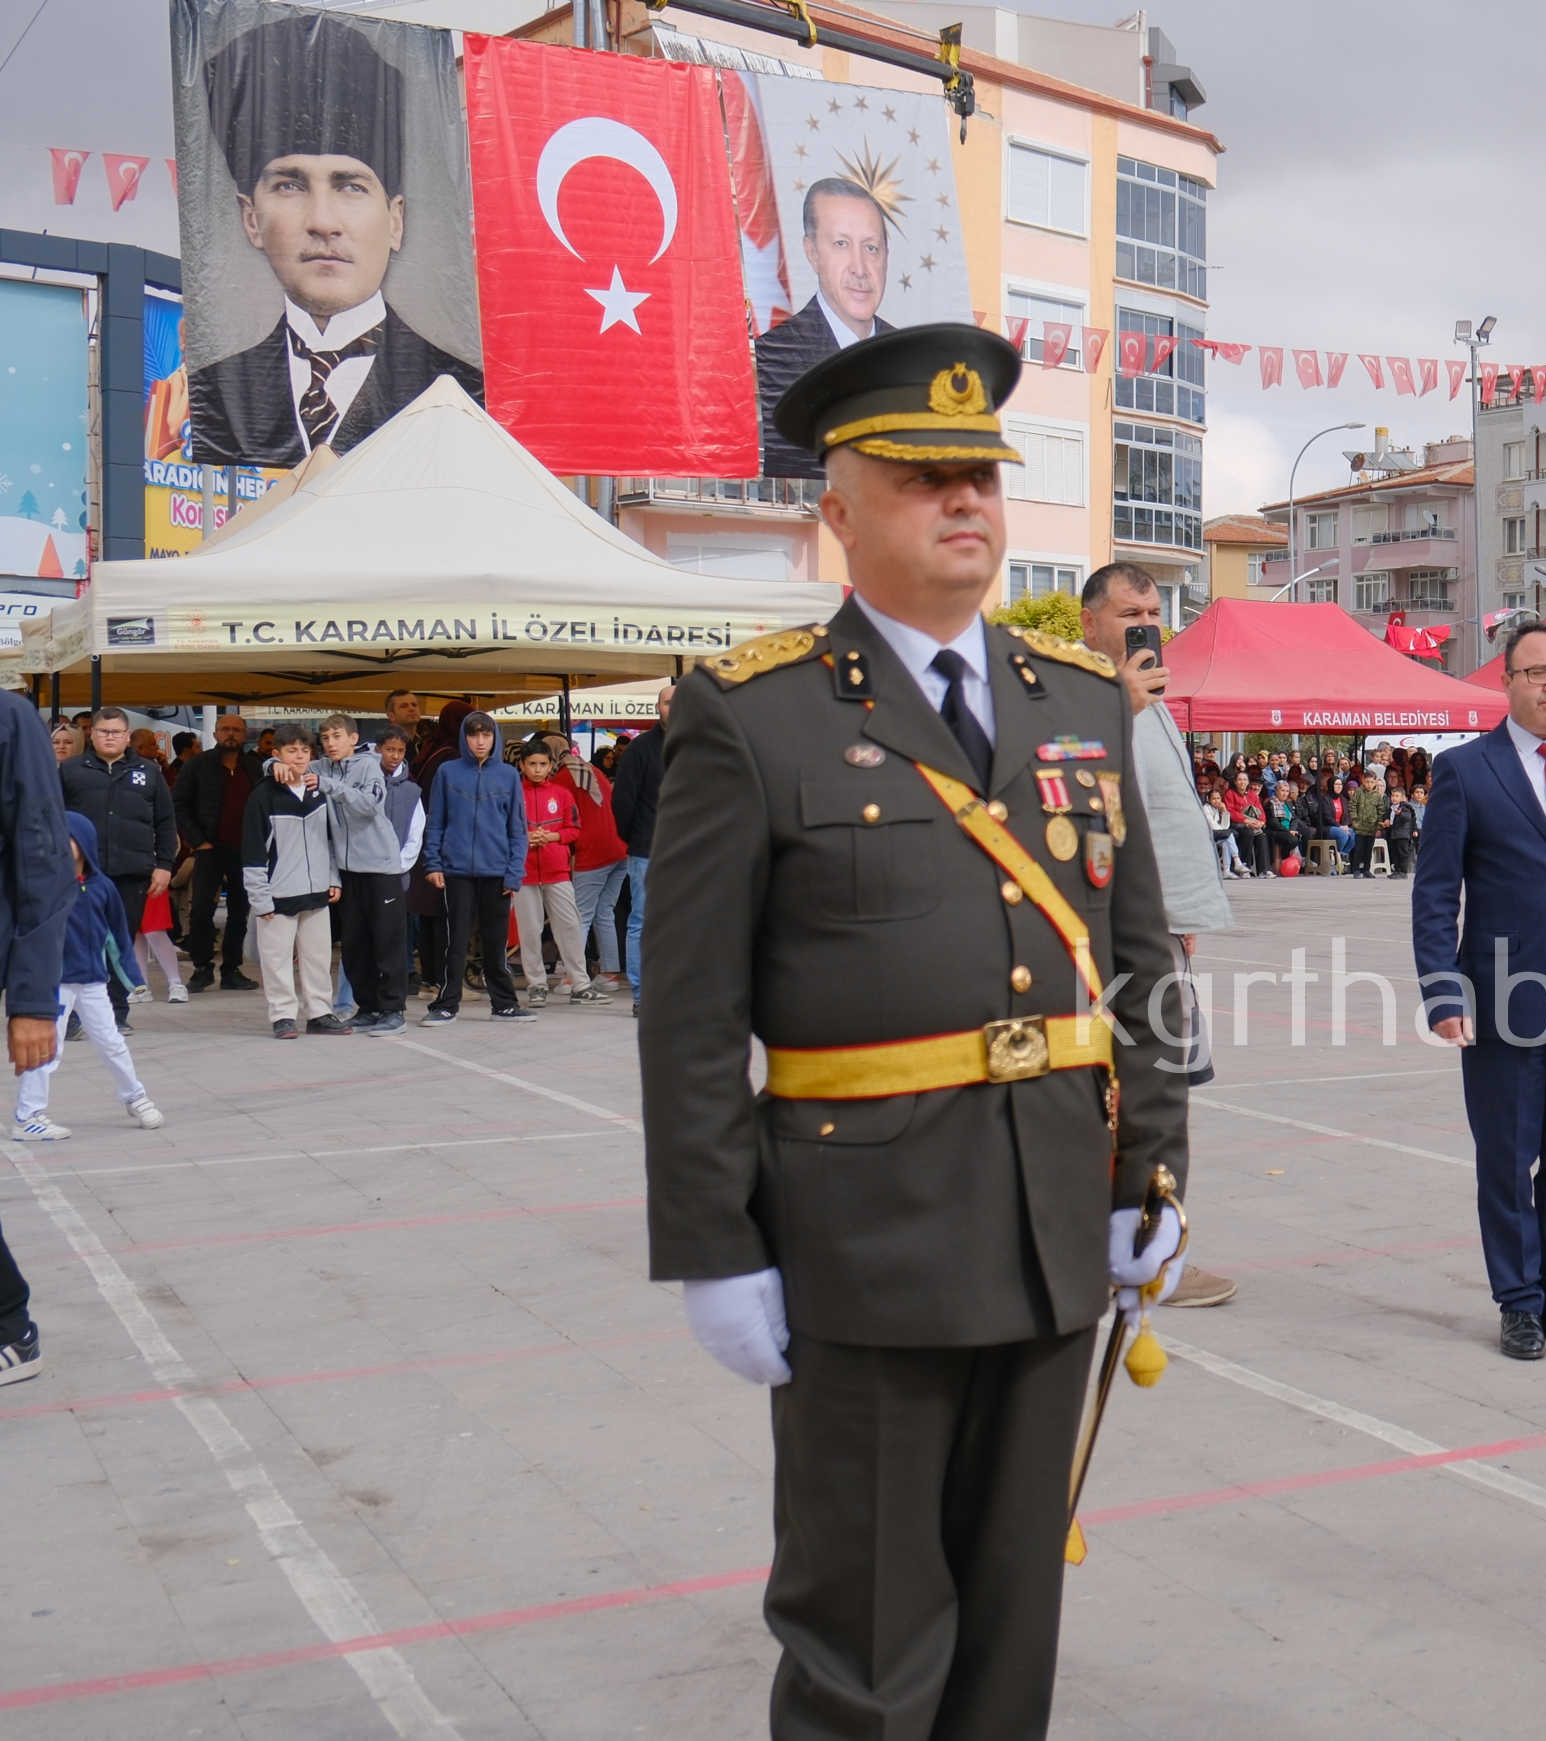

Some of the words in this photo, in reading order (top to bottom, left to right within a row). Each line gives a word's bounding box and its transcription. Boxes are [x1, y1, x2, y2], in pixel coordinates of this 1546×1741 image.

[221, 621, 284, 644] T.C.
[294, 619, 478, 644] KARAMAN
[491, 612, 518, 642] İL
[524, 613, 606, 643] ÖZEL
[612, 617, 732, 649] İDARESİ
[610, 699, 622, 715] İL
[625, 699, 660, 715] ÖZEL
[1303, 712, 1371, 727] KARAMAN
[1374, 710, 1449, 726] BELEDİYESİ
